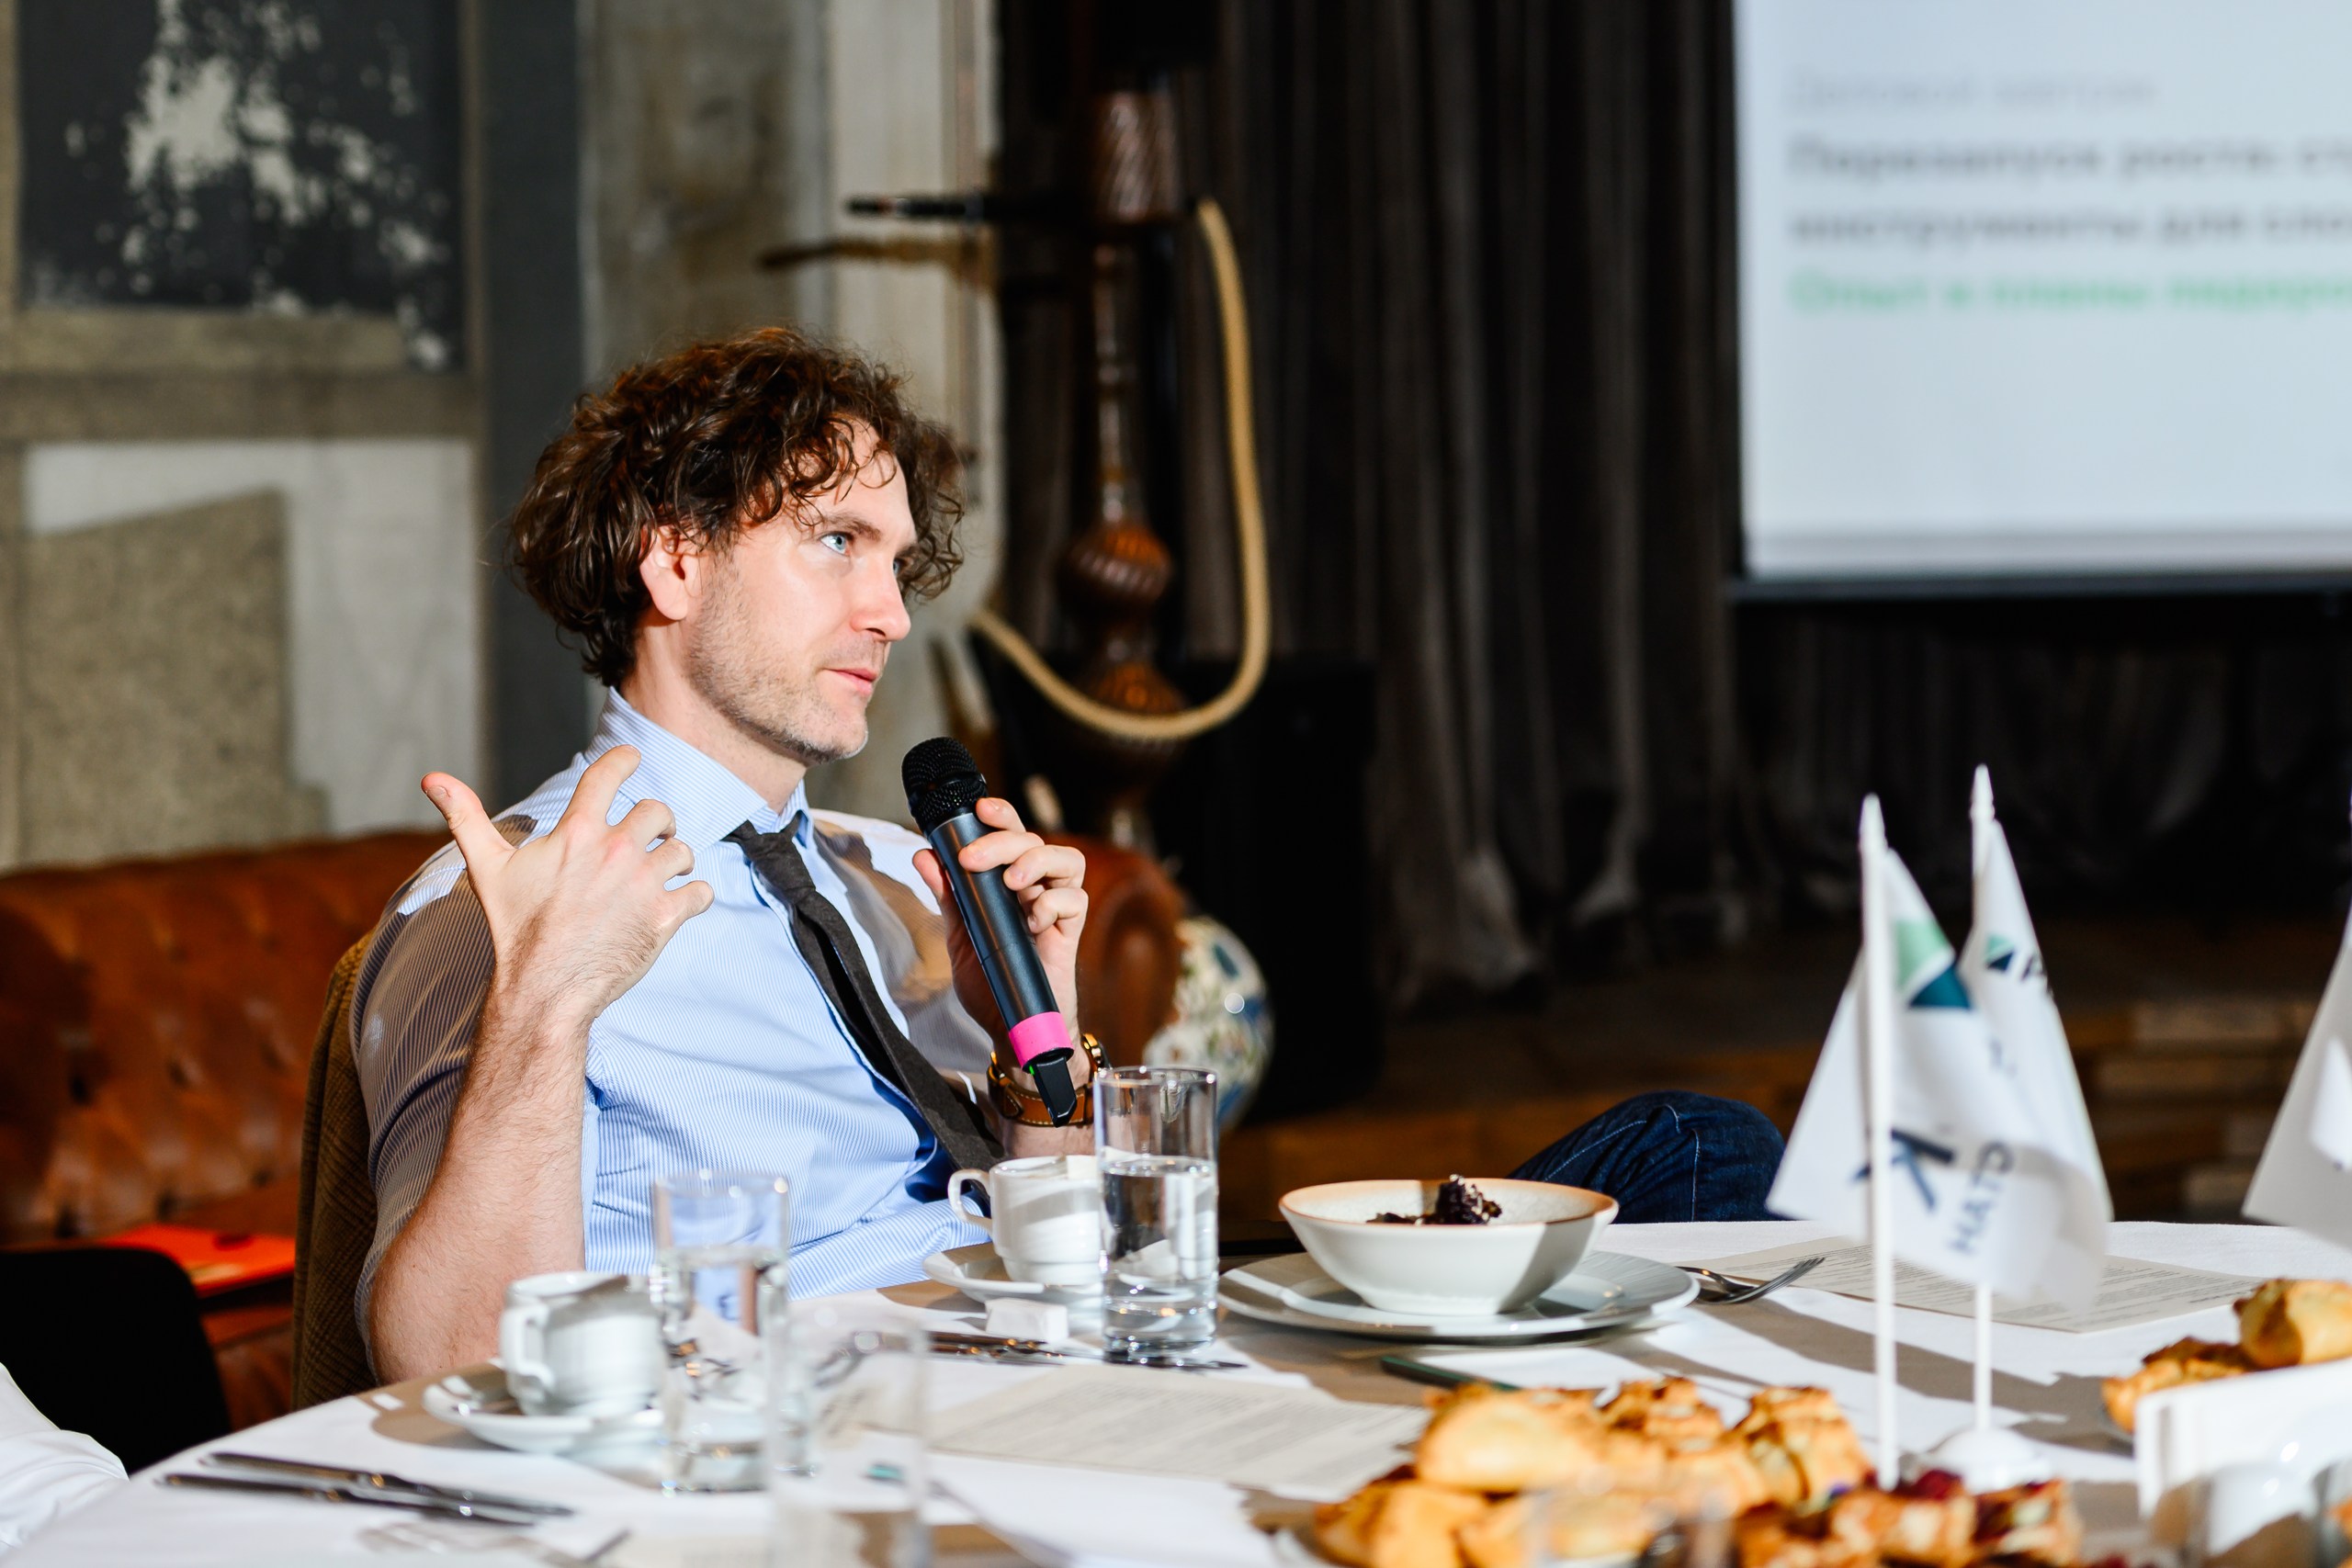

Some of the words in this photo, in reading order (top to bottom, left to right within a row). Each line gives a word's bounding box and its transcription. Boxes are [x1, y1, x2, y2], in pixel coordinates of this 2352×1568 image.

[1789, 135, 2104, 184] Перезапуск
[1790, 209, 2144, 251] инструменты
[2157, 208, 2247, 246] для
